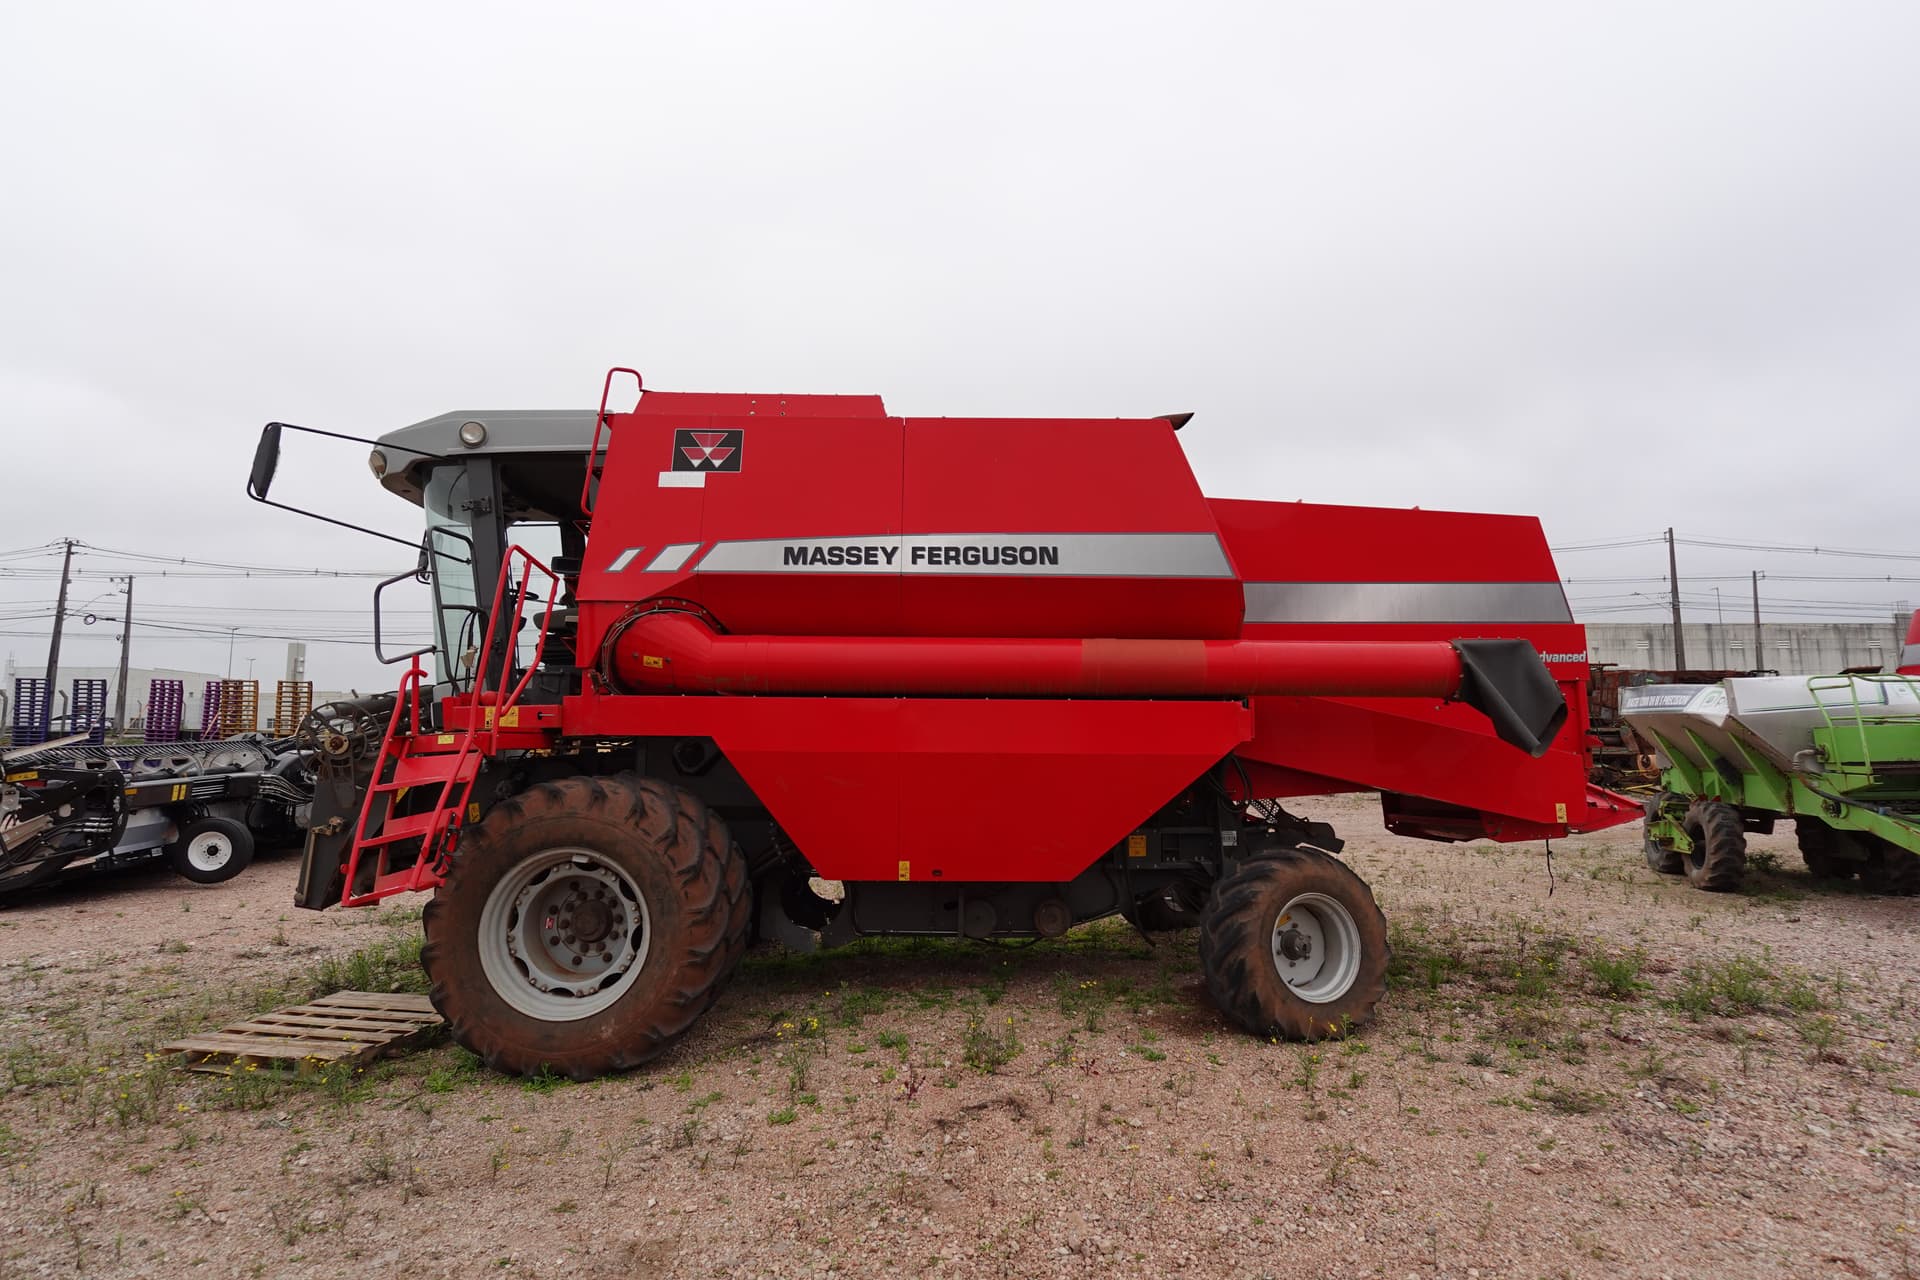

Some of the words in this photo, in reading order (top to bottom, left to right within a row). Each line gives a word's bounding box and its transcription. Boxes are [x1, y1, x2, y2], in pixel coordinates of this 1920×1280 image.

[783, 546, 899, 565] MASSEY
[911, 546, 1059, 565] FERGUSON
[1540, 651, 1586, 662] dvanced
